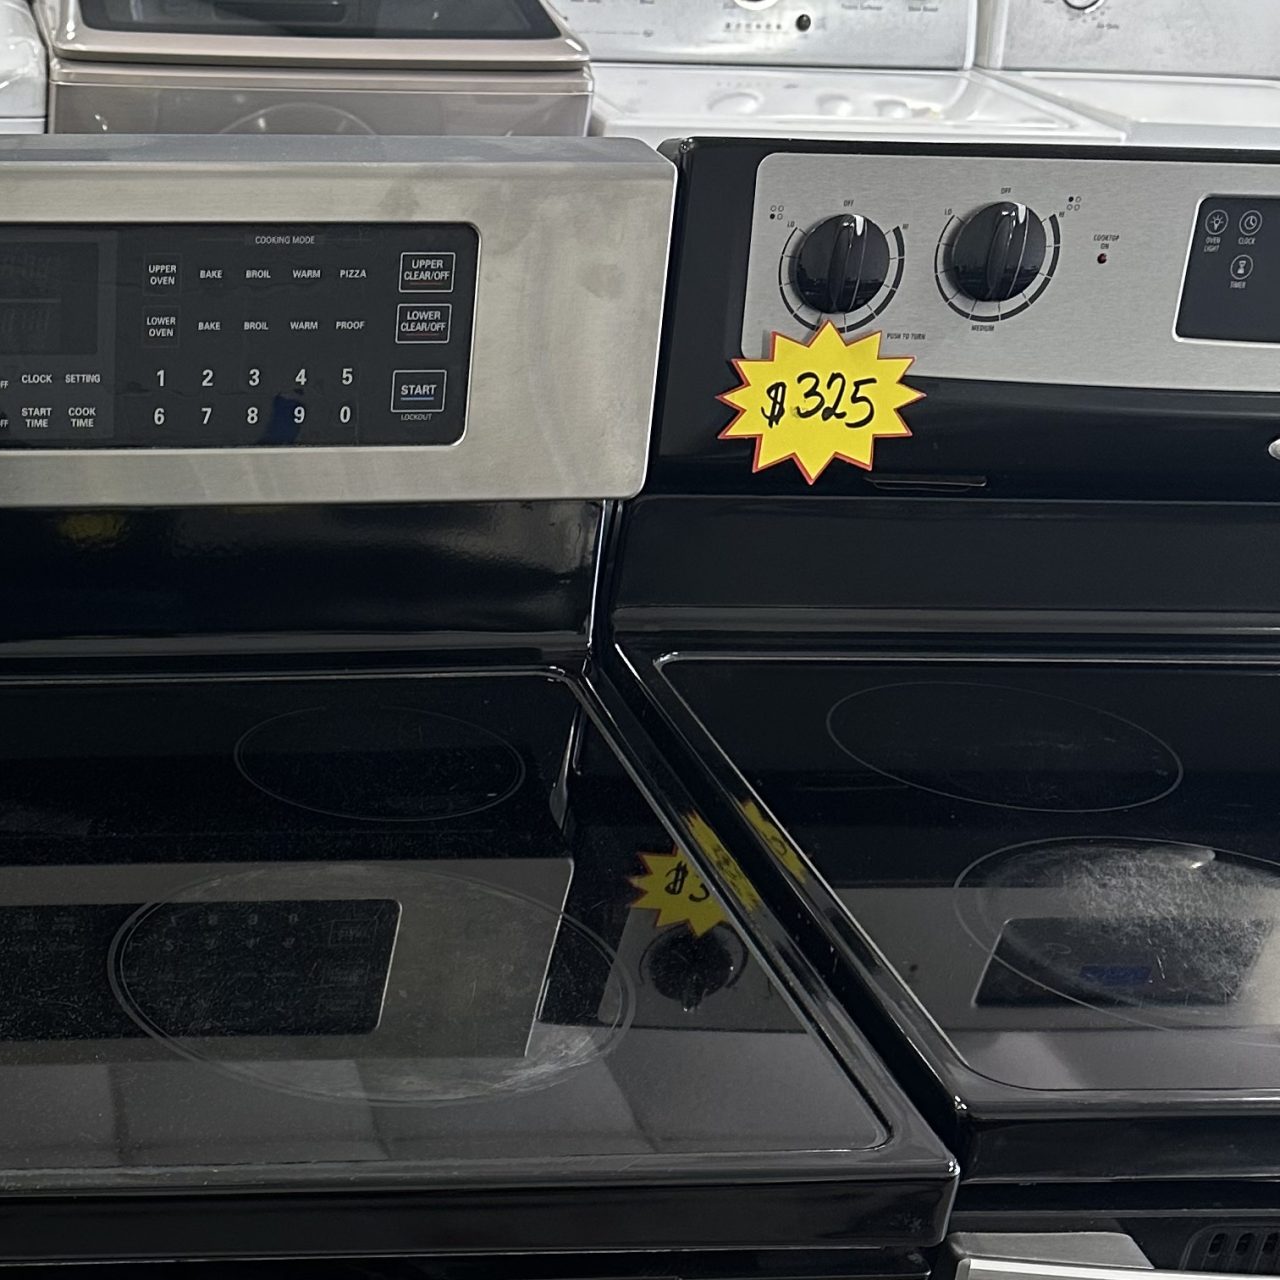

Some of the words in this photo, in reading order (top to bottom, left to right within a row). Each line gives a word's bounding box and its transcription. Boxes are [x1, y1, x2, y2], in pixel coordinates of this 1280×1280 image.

[255, 236, 291, 245] COOKING
[292, 236, 316, 244] MODE
[1238, 237, 1256, 245] CLOCK
[411, 259, 444, 269] UPPER
[148, 265, 177, 274] UPPER
[292, 270, 321, 278] WARM
[339, 269, 367, 278] PIZZA
[199, 270, 223, 279] BAKE
[245, 270, 271, 279] BROIL
[403, 271, 450, 281] CLEAR/OFF
[150, 276, 175, 285] OVEN
[406, 311, 441, 320] LOWER
[146, 317, 176, 326] LOWER
[243, 321, 269, 330] BROIL
[290, 321, 318, 330] WARM
[335, 321, 365, 330] PROOF
[198, 322, 221, 331] BAKE
[400, 322, 447, 332] CLEAR/OFF
[148, 328, 174, 337] OVEN
[21, 374, 53, 384] CLOCK
[65, 374, 101, 384] SETTING
[156, 369, 165, 387] 1
[202, 369, 214, 387] 2
[249, 368, 260, 386] 3
[295, 368, 307, 386] 4
[342, 368, 353, 385] 5
[401, 385, 437, 395] START
[761, 372, 877, 428] $325
[21, 407, 52, 417] START
[68, 407, 97, 416] COOK
[154, 407, 165, 425] 6
[201, 407, 212, 424] 7
[247, 407, 258, 424] 8
[293, 406, 305, 424] 9
[339, 406, 351, 423] 0
[25, 419, 49, 428] TIME
[70, 419, 94, 428] TIME
